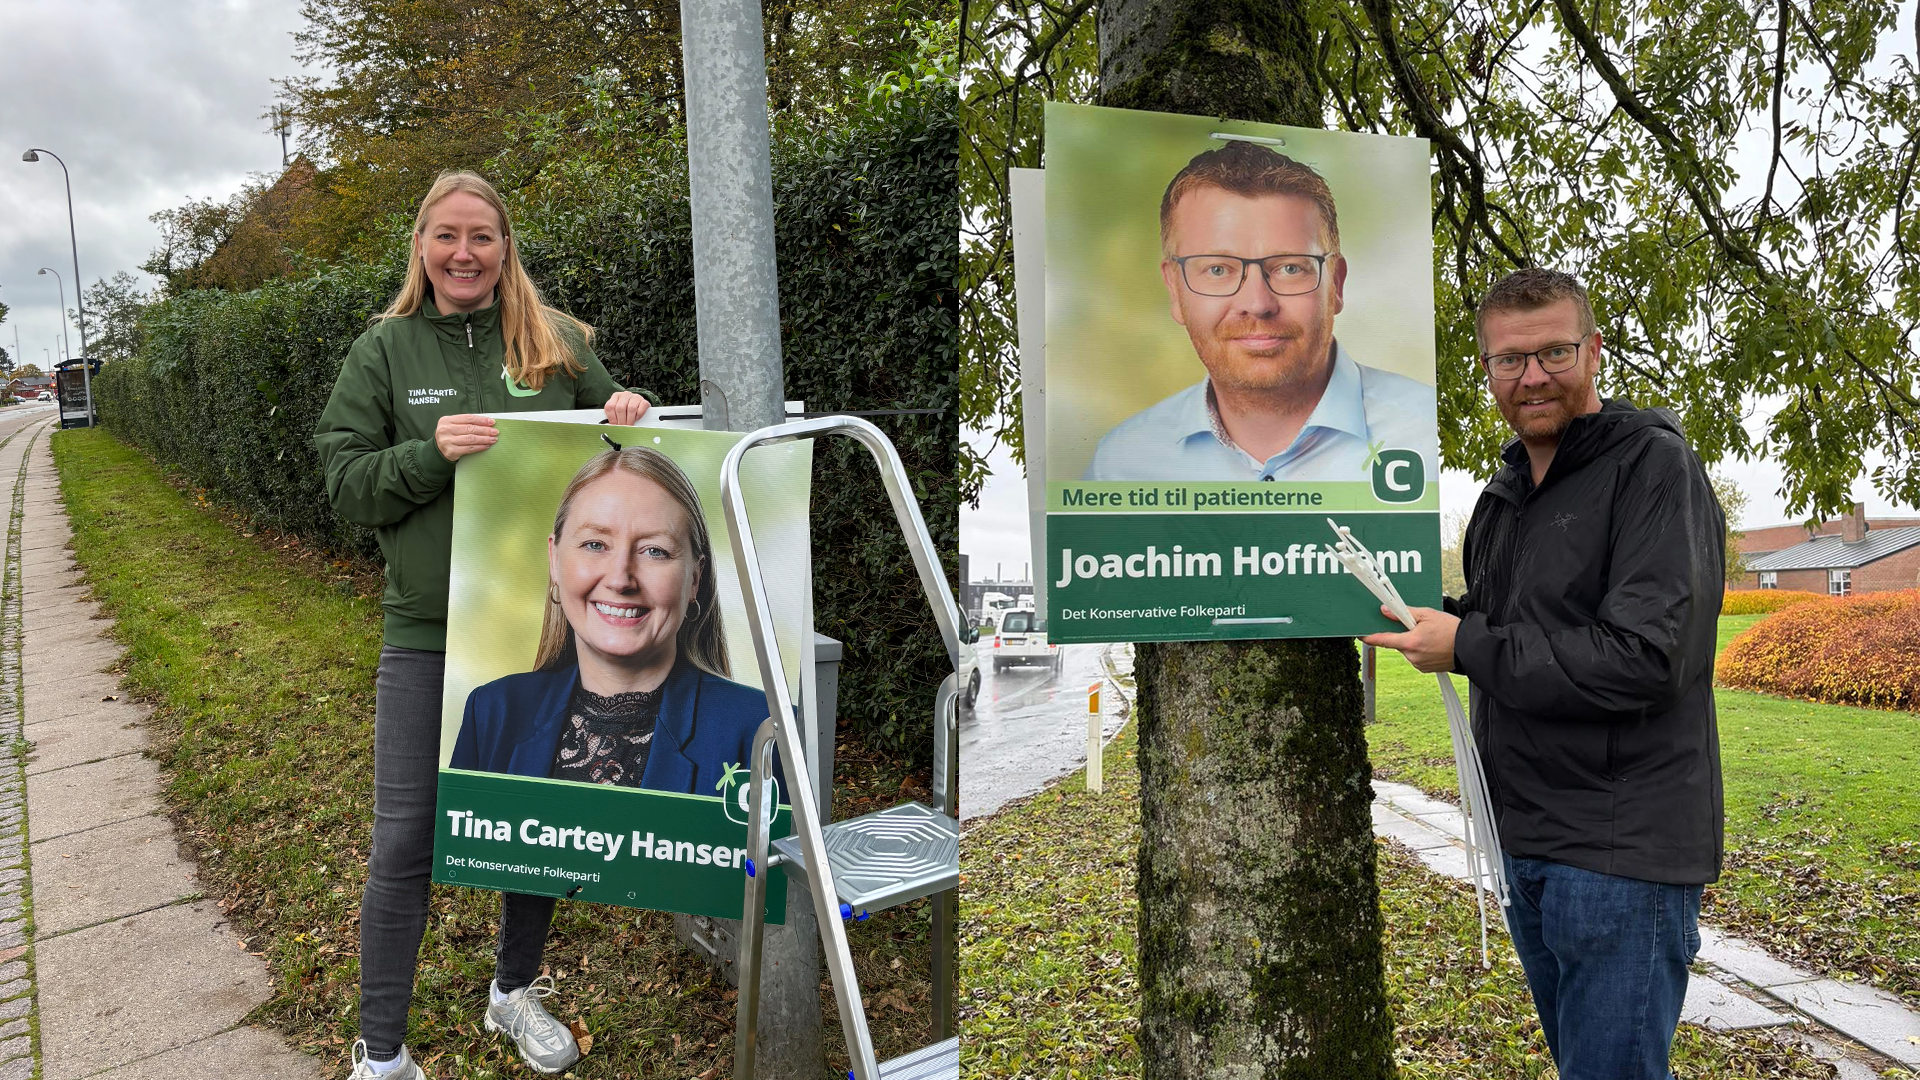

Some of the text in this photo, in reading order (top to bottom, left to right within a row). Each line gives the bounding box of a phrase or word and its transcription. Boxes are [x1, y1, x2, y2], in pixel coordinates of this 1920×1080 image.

[408, 388, 458, 397] TINA CARTEY
[408, 396, 440, 406] HANSEN
[1384, 459, 1411, 492] C
[1062, 487, 1323, 511] Mere tid til patienterne
[1055, 543, 1422, 588] Joachim Hoffmnn
[1062, 604, 1246, 620] Det Konservative Folkeparti
[446, 809, 748, 870] Tina Cartey Hansen
[445, 854, 601, 883] Det Konservative Folkeparti
